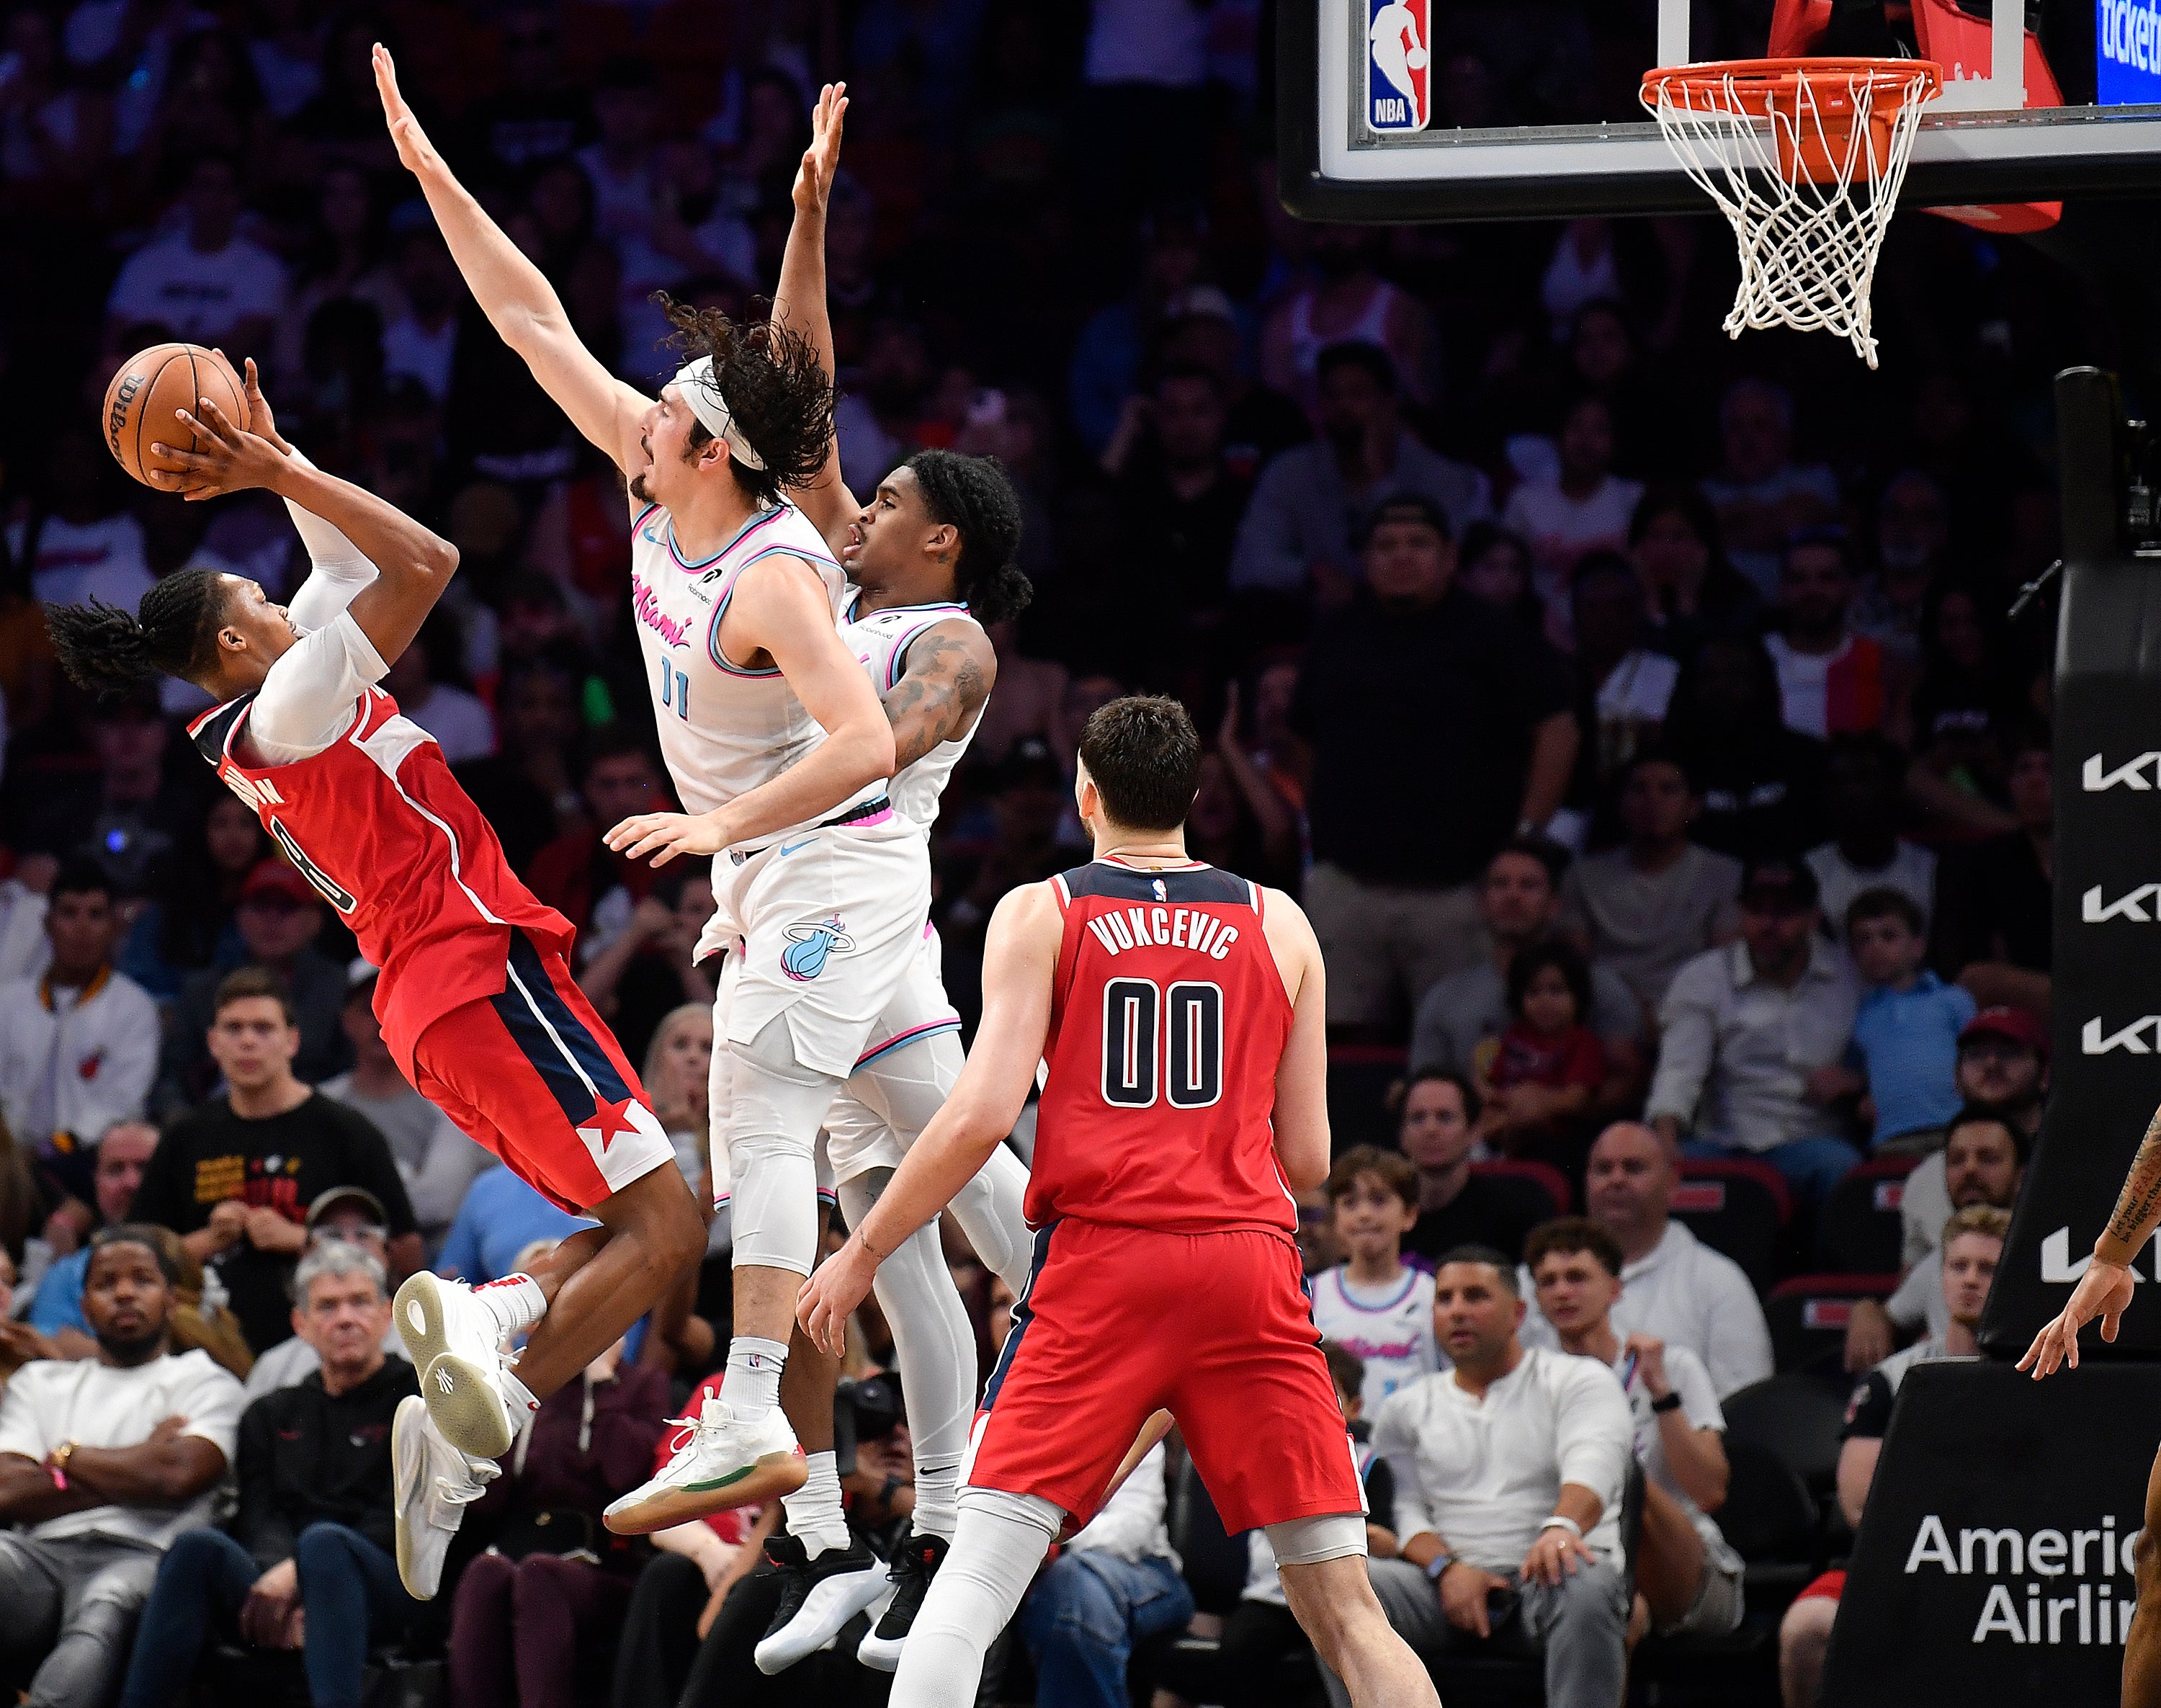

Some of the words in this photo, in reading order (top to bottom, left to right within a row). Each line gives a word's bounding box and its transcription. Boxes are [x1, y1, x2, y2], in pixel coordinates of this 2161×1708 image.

[2101, 0, 2161, 75] ticket
[1375, 98, 1406, 122] NBA
[632, 574, 692, 648] Miami
[662, 656, 689, 722] 11
[1086, 907, 1239, 960] VUKCEVIC
[1101, 977, 1223, 1109] 00
